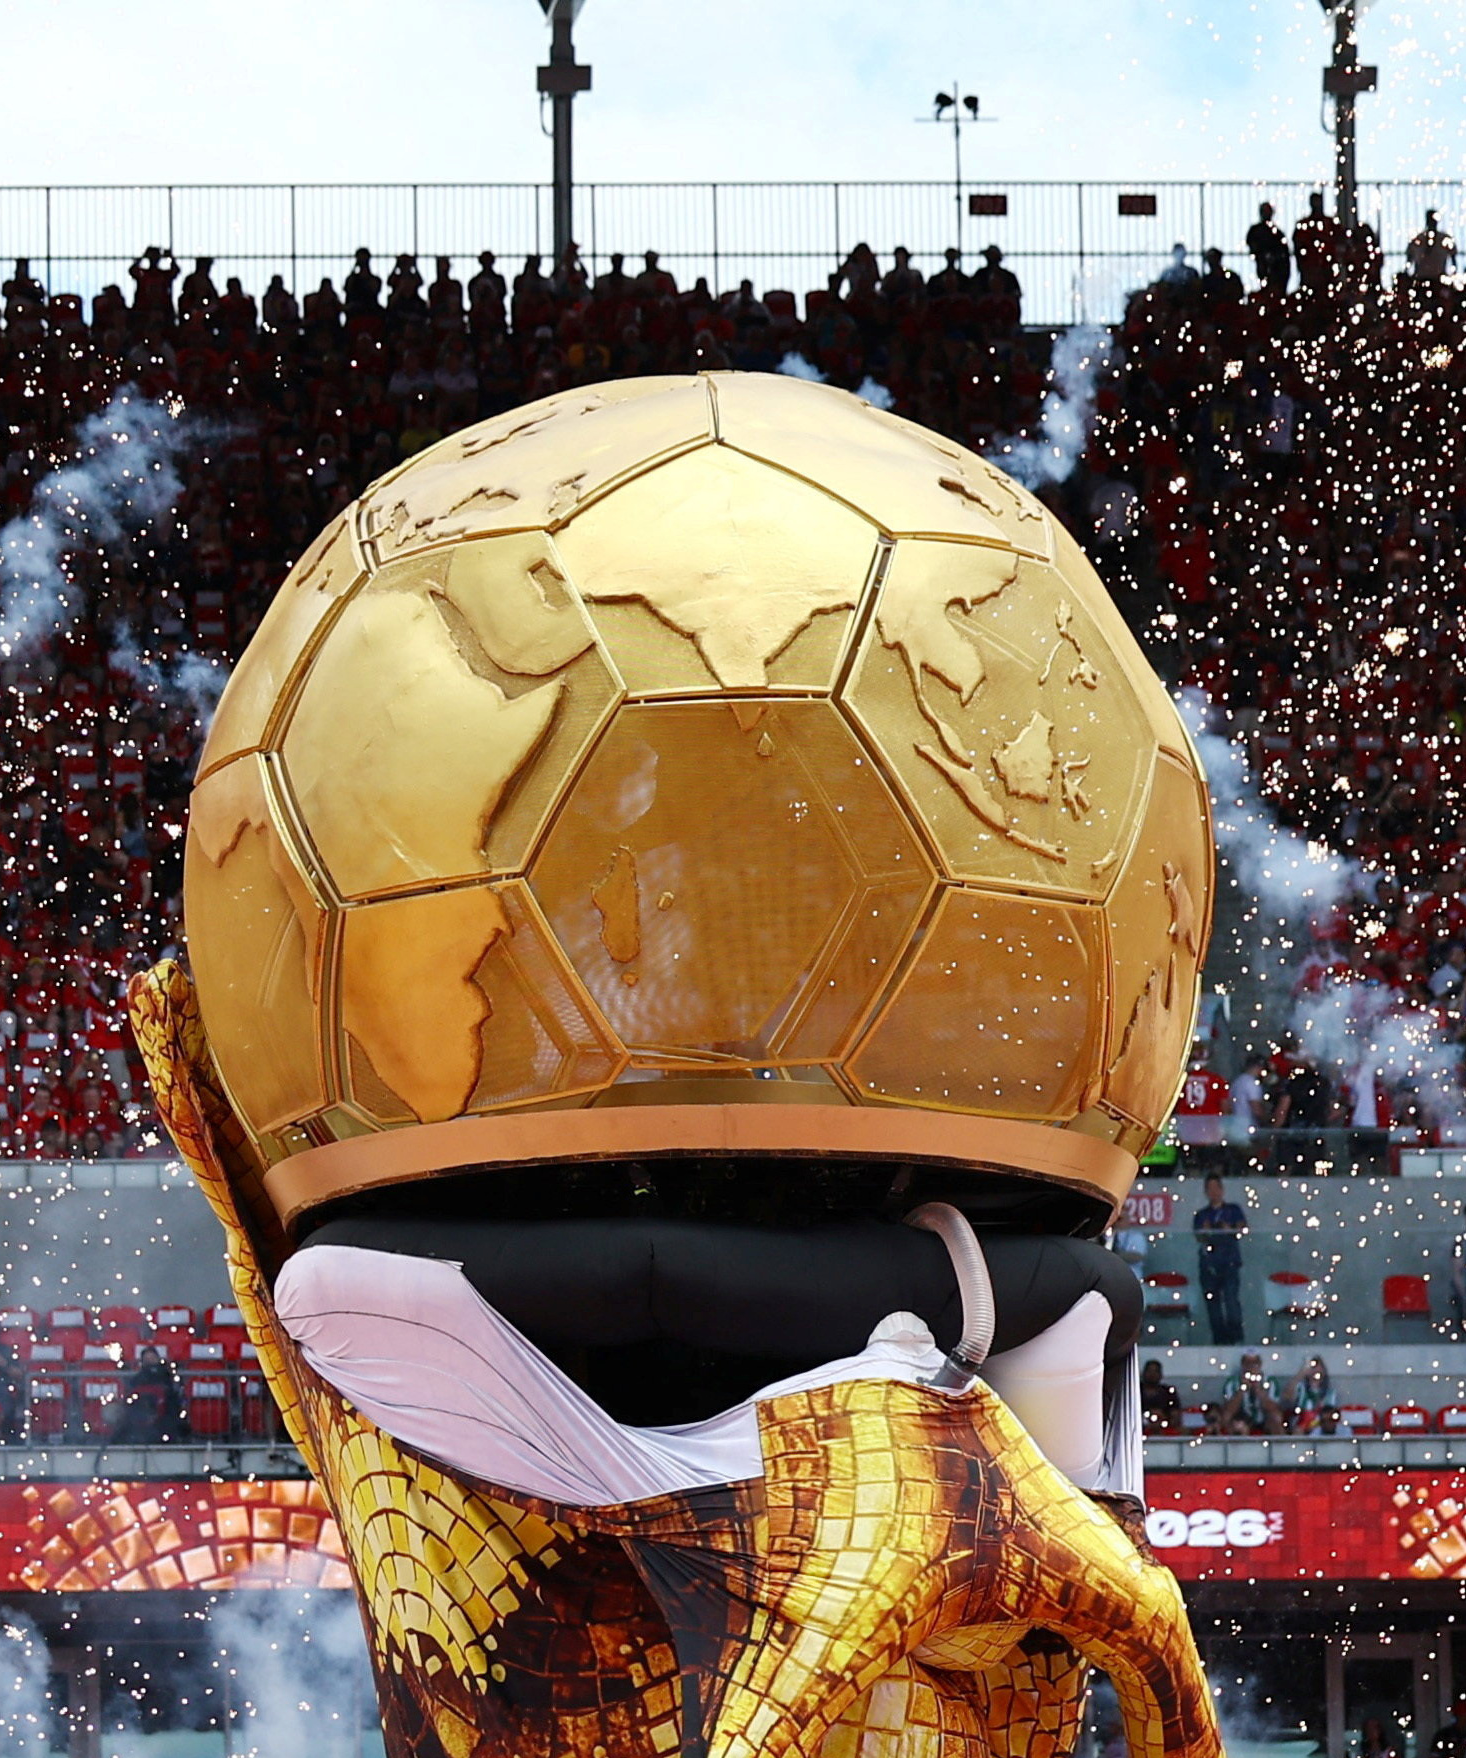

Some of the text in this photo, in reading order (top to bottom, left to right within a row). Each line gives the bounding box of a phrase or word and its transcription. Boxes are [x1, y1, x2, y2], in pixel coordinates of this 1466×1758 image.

[1186, 1083, 1206, 1106] 19
[1125, 1197, 1165, 1223] 208
[1145, 1509, 1267, 1548] 026
